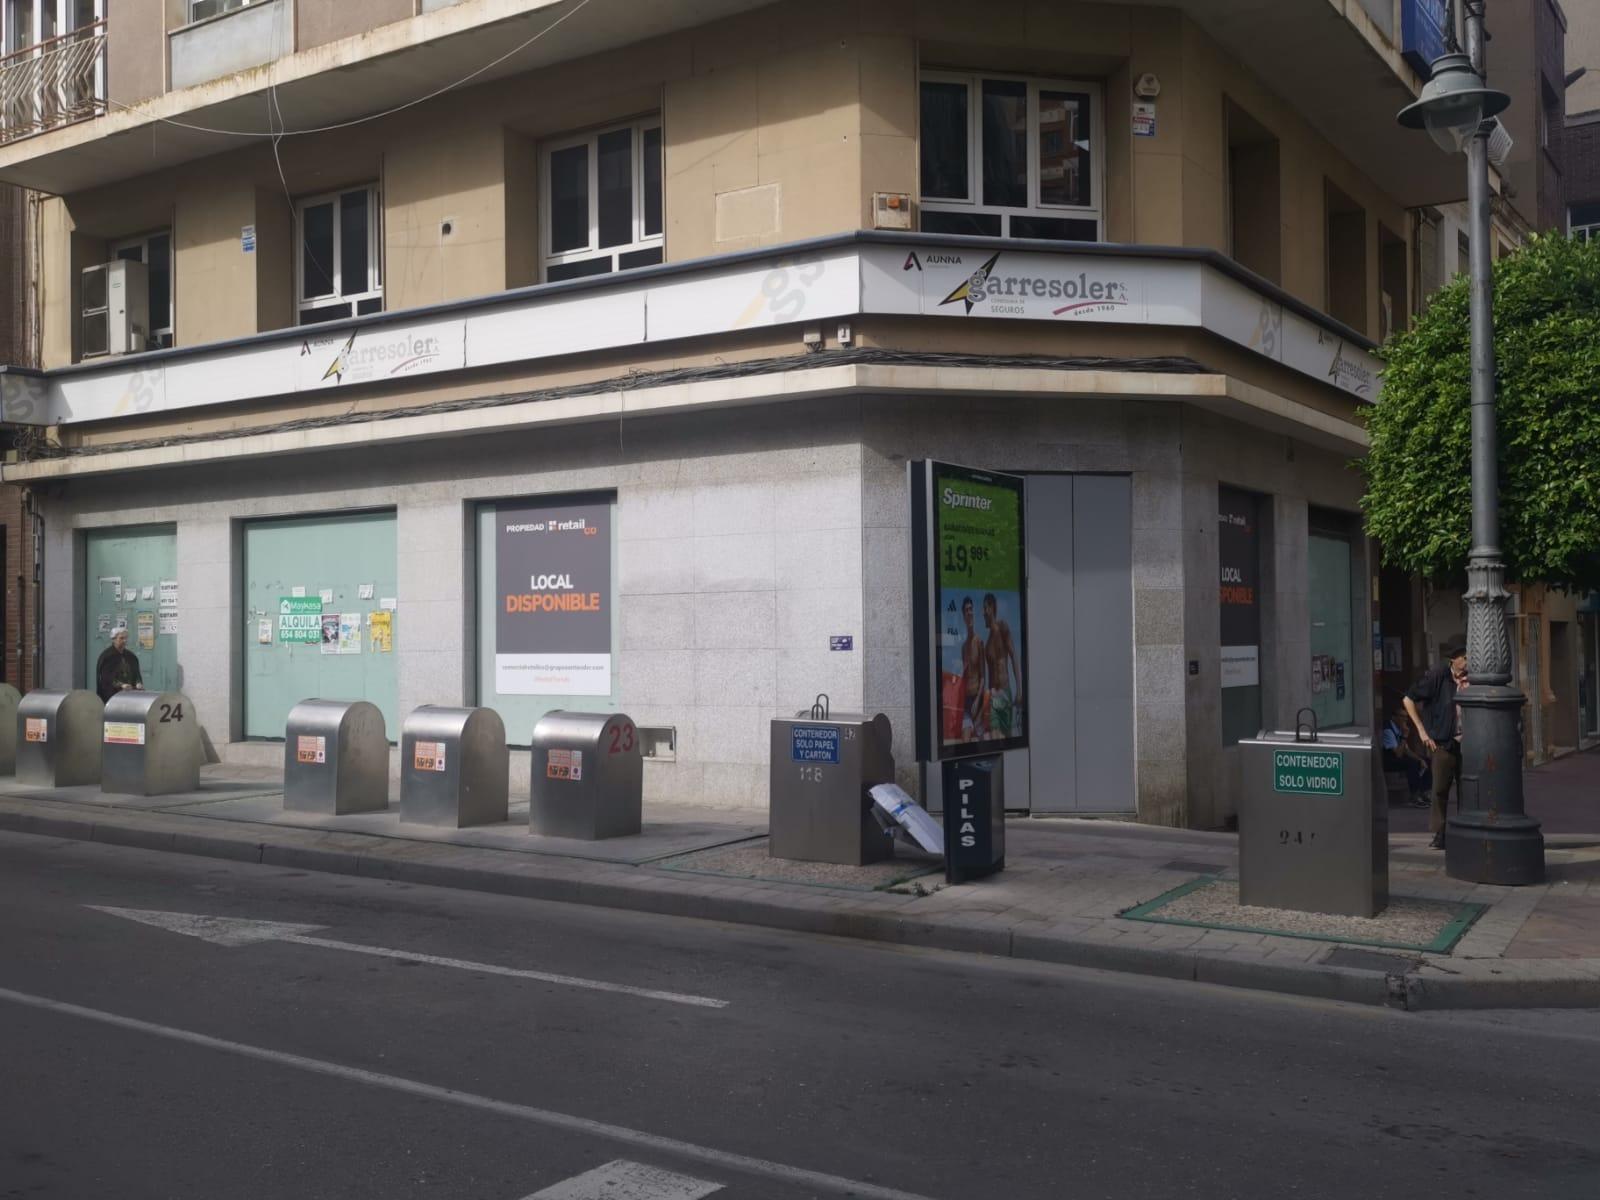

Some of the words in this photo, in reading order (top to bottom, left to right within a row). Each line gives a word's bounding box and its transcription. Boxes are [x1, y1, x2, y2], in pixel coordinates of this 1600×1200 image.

[926, 255, 961, 265] AUNNA
[967, 269, 1119, 303] garresoler
[991, 305, 1024, 315] SEGUROS
[943, 487, 993, 510] Sprinter
[506, 523, 544, 533] PROPIEDAD
[558, 519, 585, 531] retail
[531, 573, 573, 590] LOCAL
[1221, 567, 1242, 583] LOCAL
[506, 592, 600, 613] DISPONIBLE
[281, 615, 320, 628] ALQUILA
[160, 703, 183, 723] 24
[608, 723, 634, 754] 23
[794, 729, 837, 740] CONTENEDOR
[796, 739, 814, 749] SOLO
[815, 740, 835, 750] PAPEL
[800, 750, 805, 758] Y
[1276, 754, 1339, 769] CONTENEDOR
[1279, 775, 1303, 788] SOLO
[1306, 776, 1337, 790] VIDRIO
[959, 779, 976, 847] PILAS
